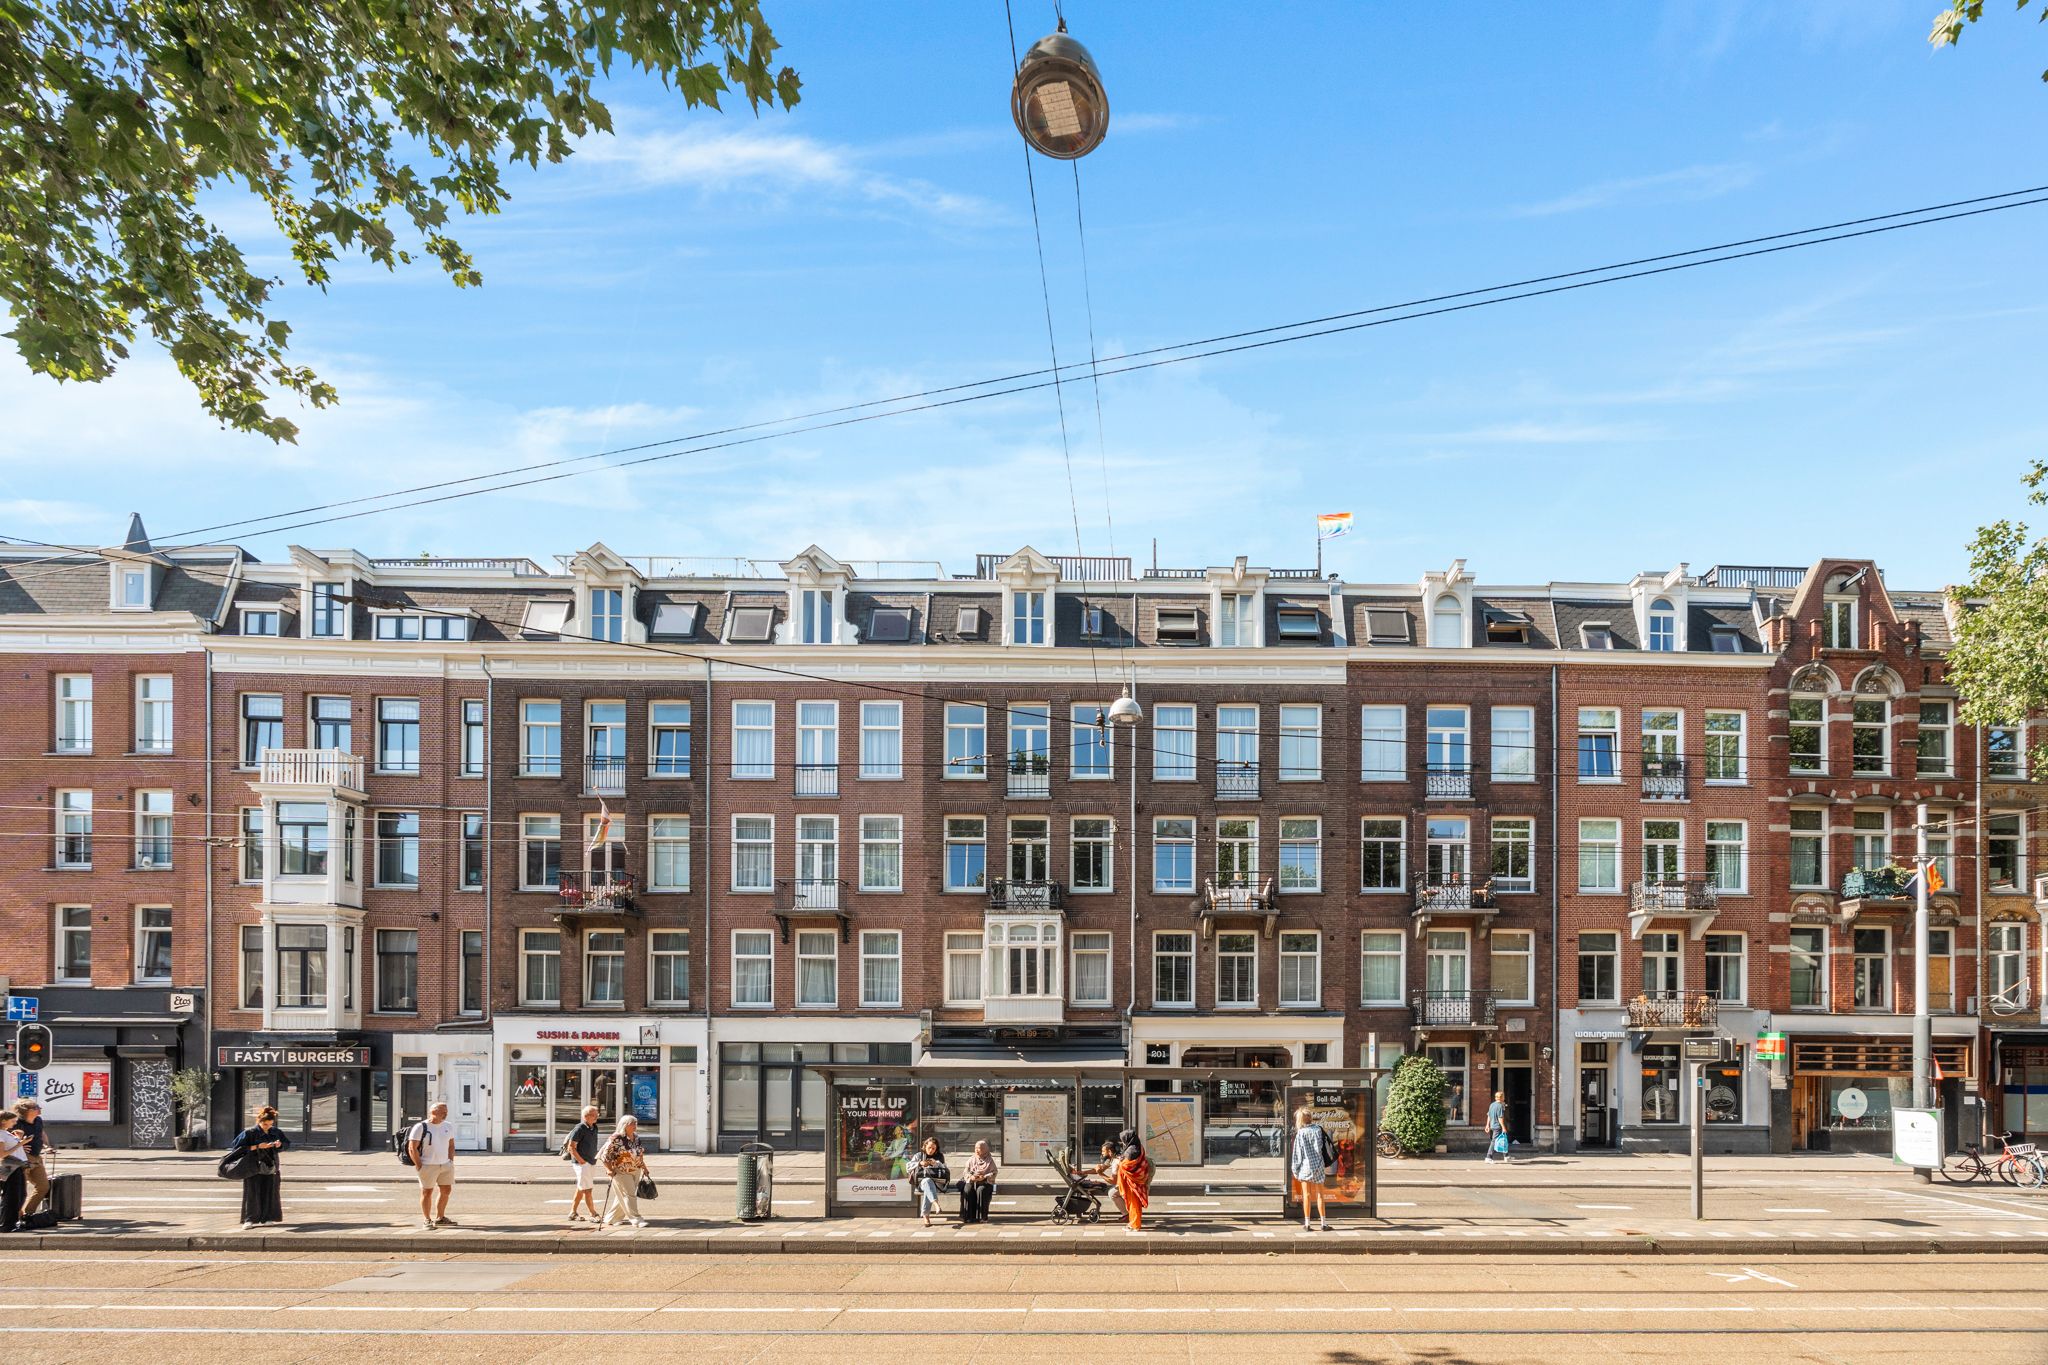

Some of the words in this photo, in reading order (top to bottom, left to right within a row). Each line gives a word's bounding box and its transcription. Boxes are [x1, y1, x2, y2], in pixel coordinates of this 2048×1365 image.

[174, 996, 191, 1007] Etos
[536, 1031, 569, 1040] SUSHI
[571, 1032, 579, 1040] &
[581, 1031, 620, 1040] RAMEN
[1575, 1031, 1626, 1040] warungmini
[234, 1051, 280, 1062] FASTY
[287, 1051, 354, 1062] BURGERS
[1151, 1050, 1166, 1058] 201
[1643, 1054, 1676, 1062] warungmini
[44, 1078, 75, 1097] Etos
[955, 1091, 1000, 1099] DIERENKLINIE
[842, 1097, 885, 1109] LEVEL
[887, 1097, 907, 1108] UP
[869, 1110, 902, 1118] SUMMER!
